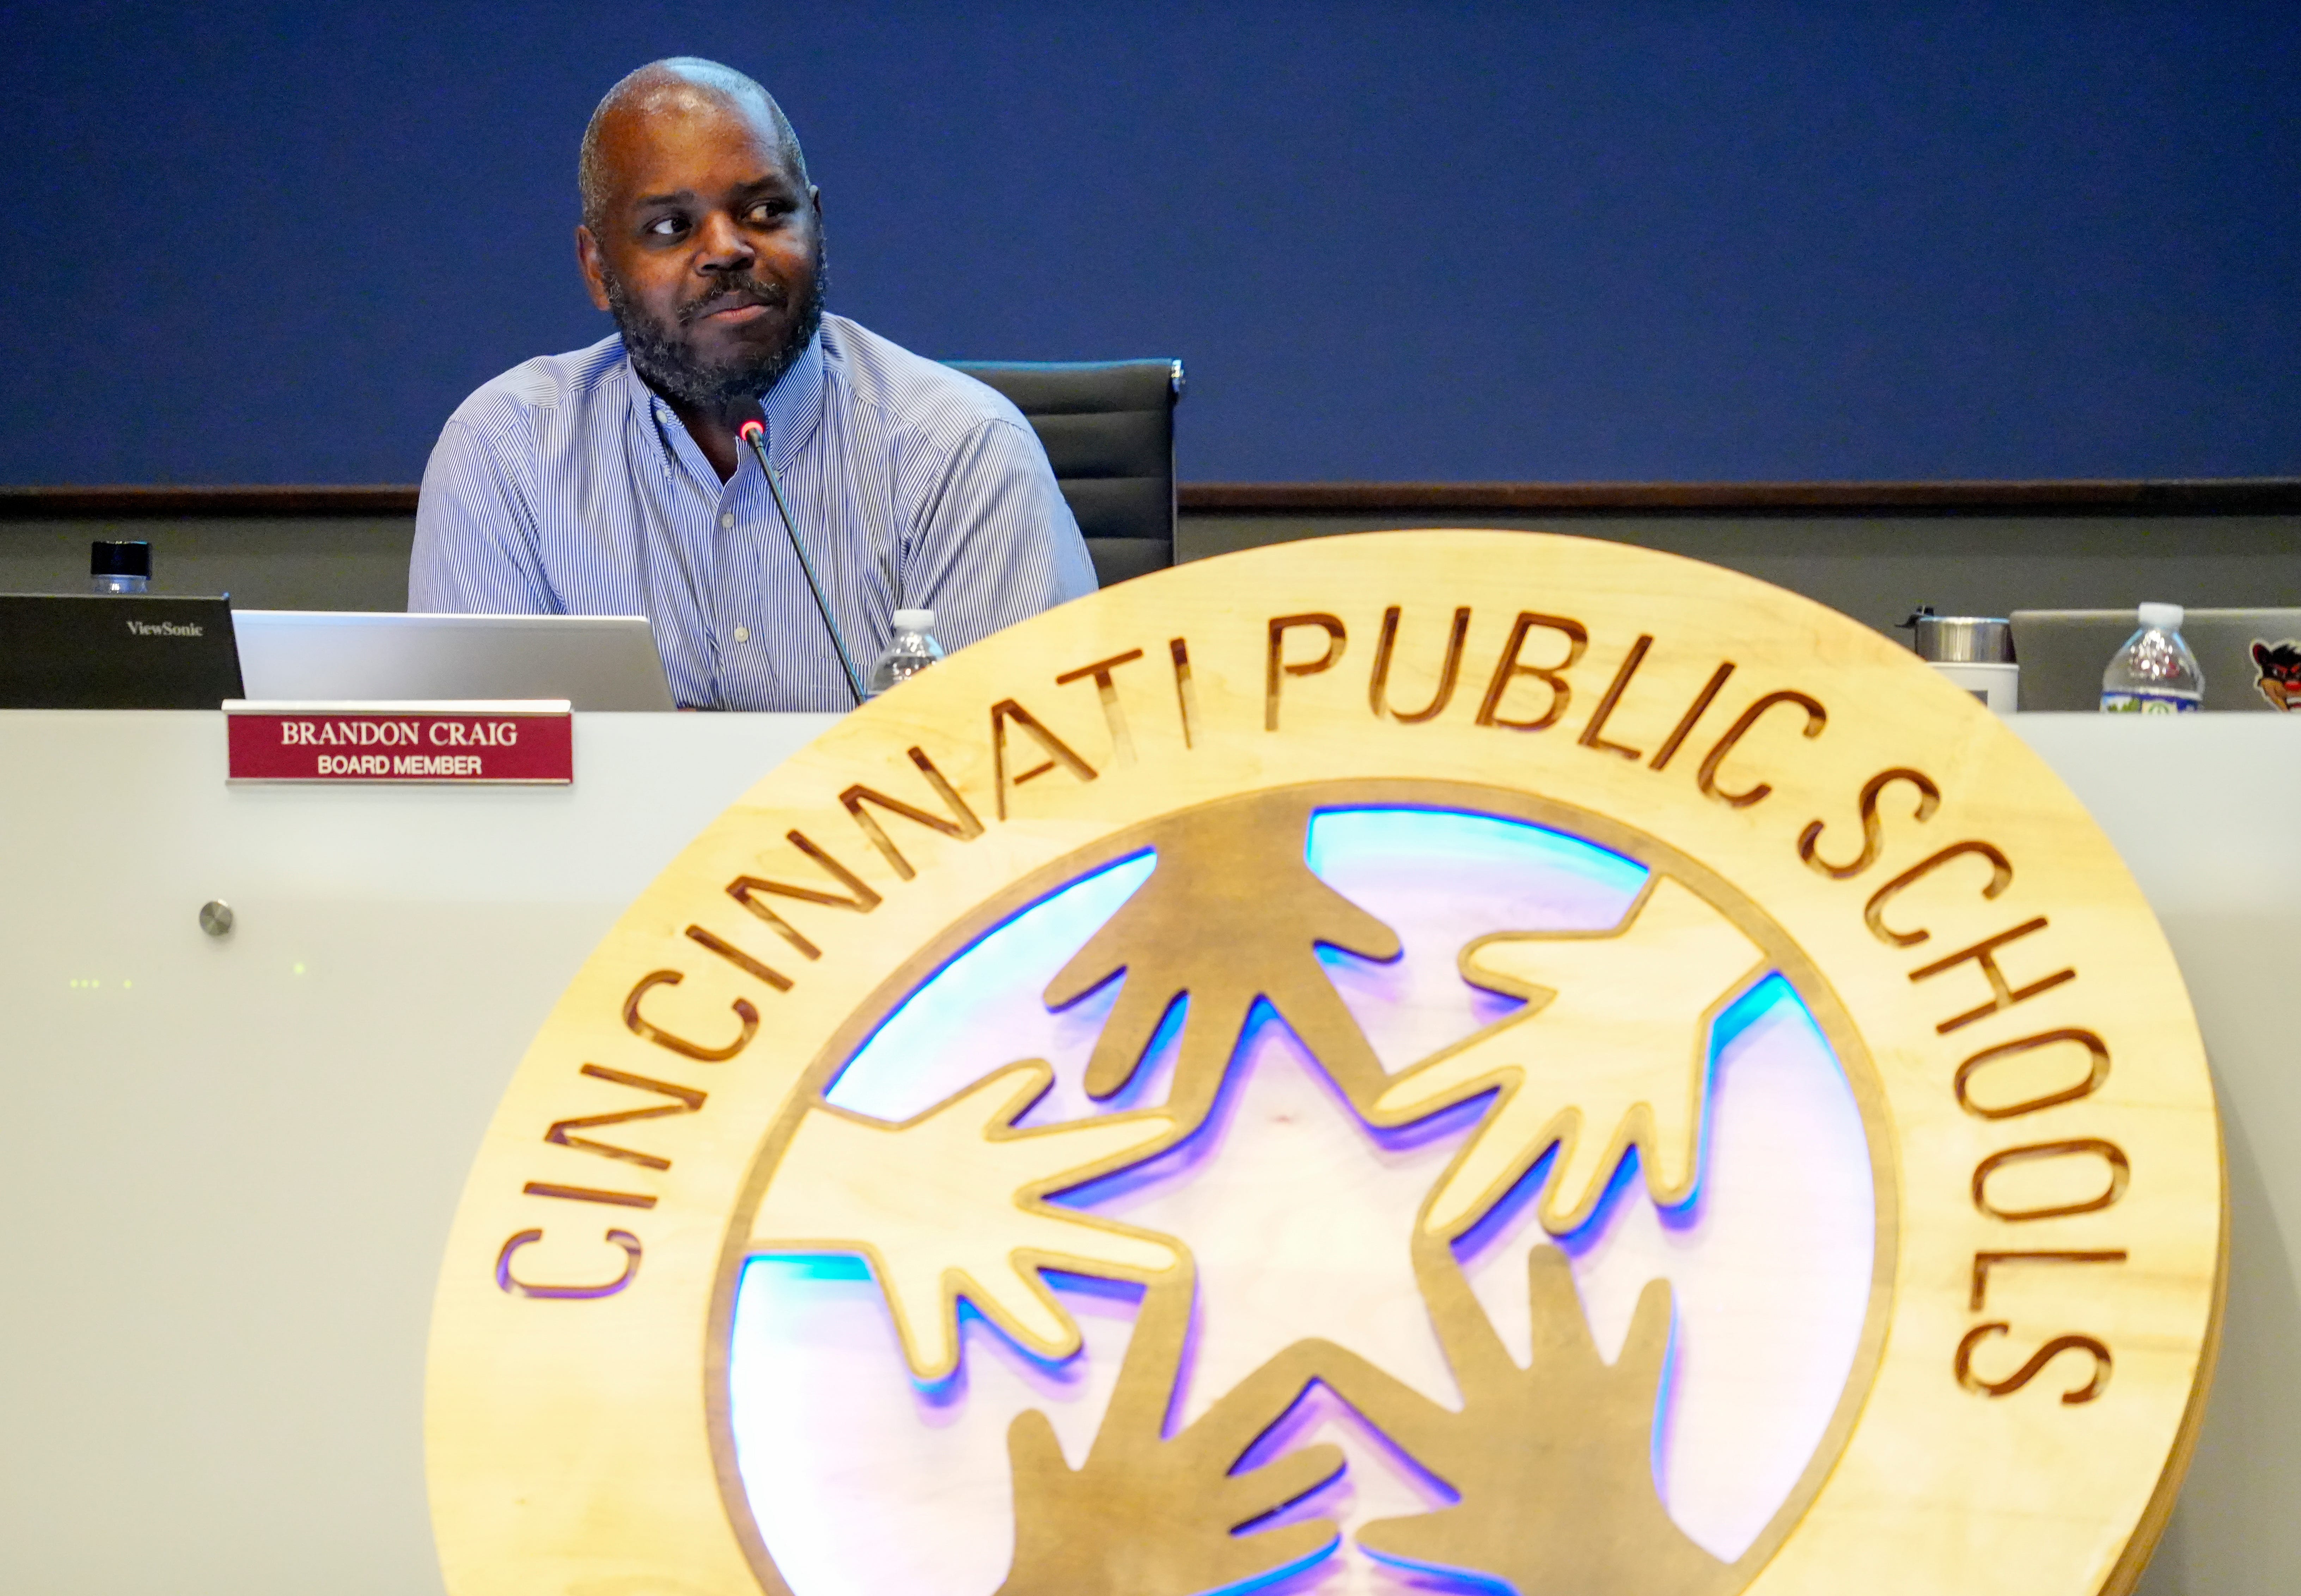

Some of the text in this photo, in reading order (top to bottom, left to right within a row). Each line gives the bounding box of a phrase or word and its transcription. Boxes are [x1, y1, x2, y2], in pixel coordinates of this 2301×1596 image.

[126, 621, 203, 636] ViewSonic
[281, 721, 518, 746] BRANDON CRAIG
[318, 755, 482, 775] BOARD MEMBER
[495, 604, 2131, 1407] CINCINNATI PUBLIC SCHOOLS
